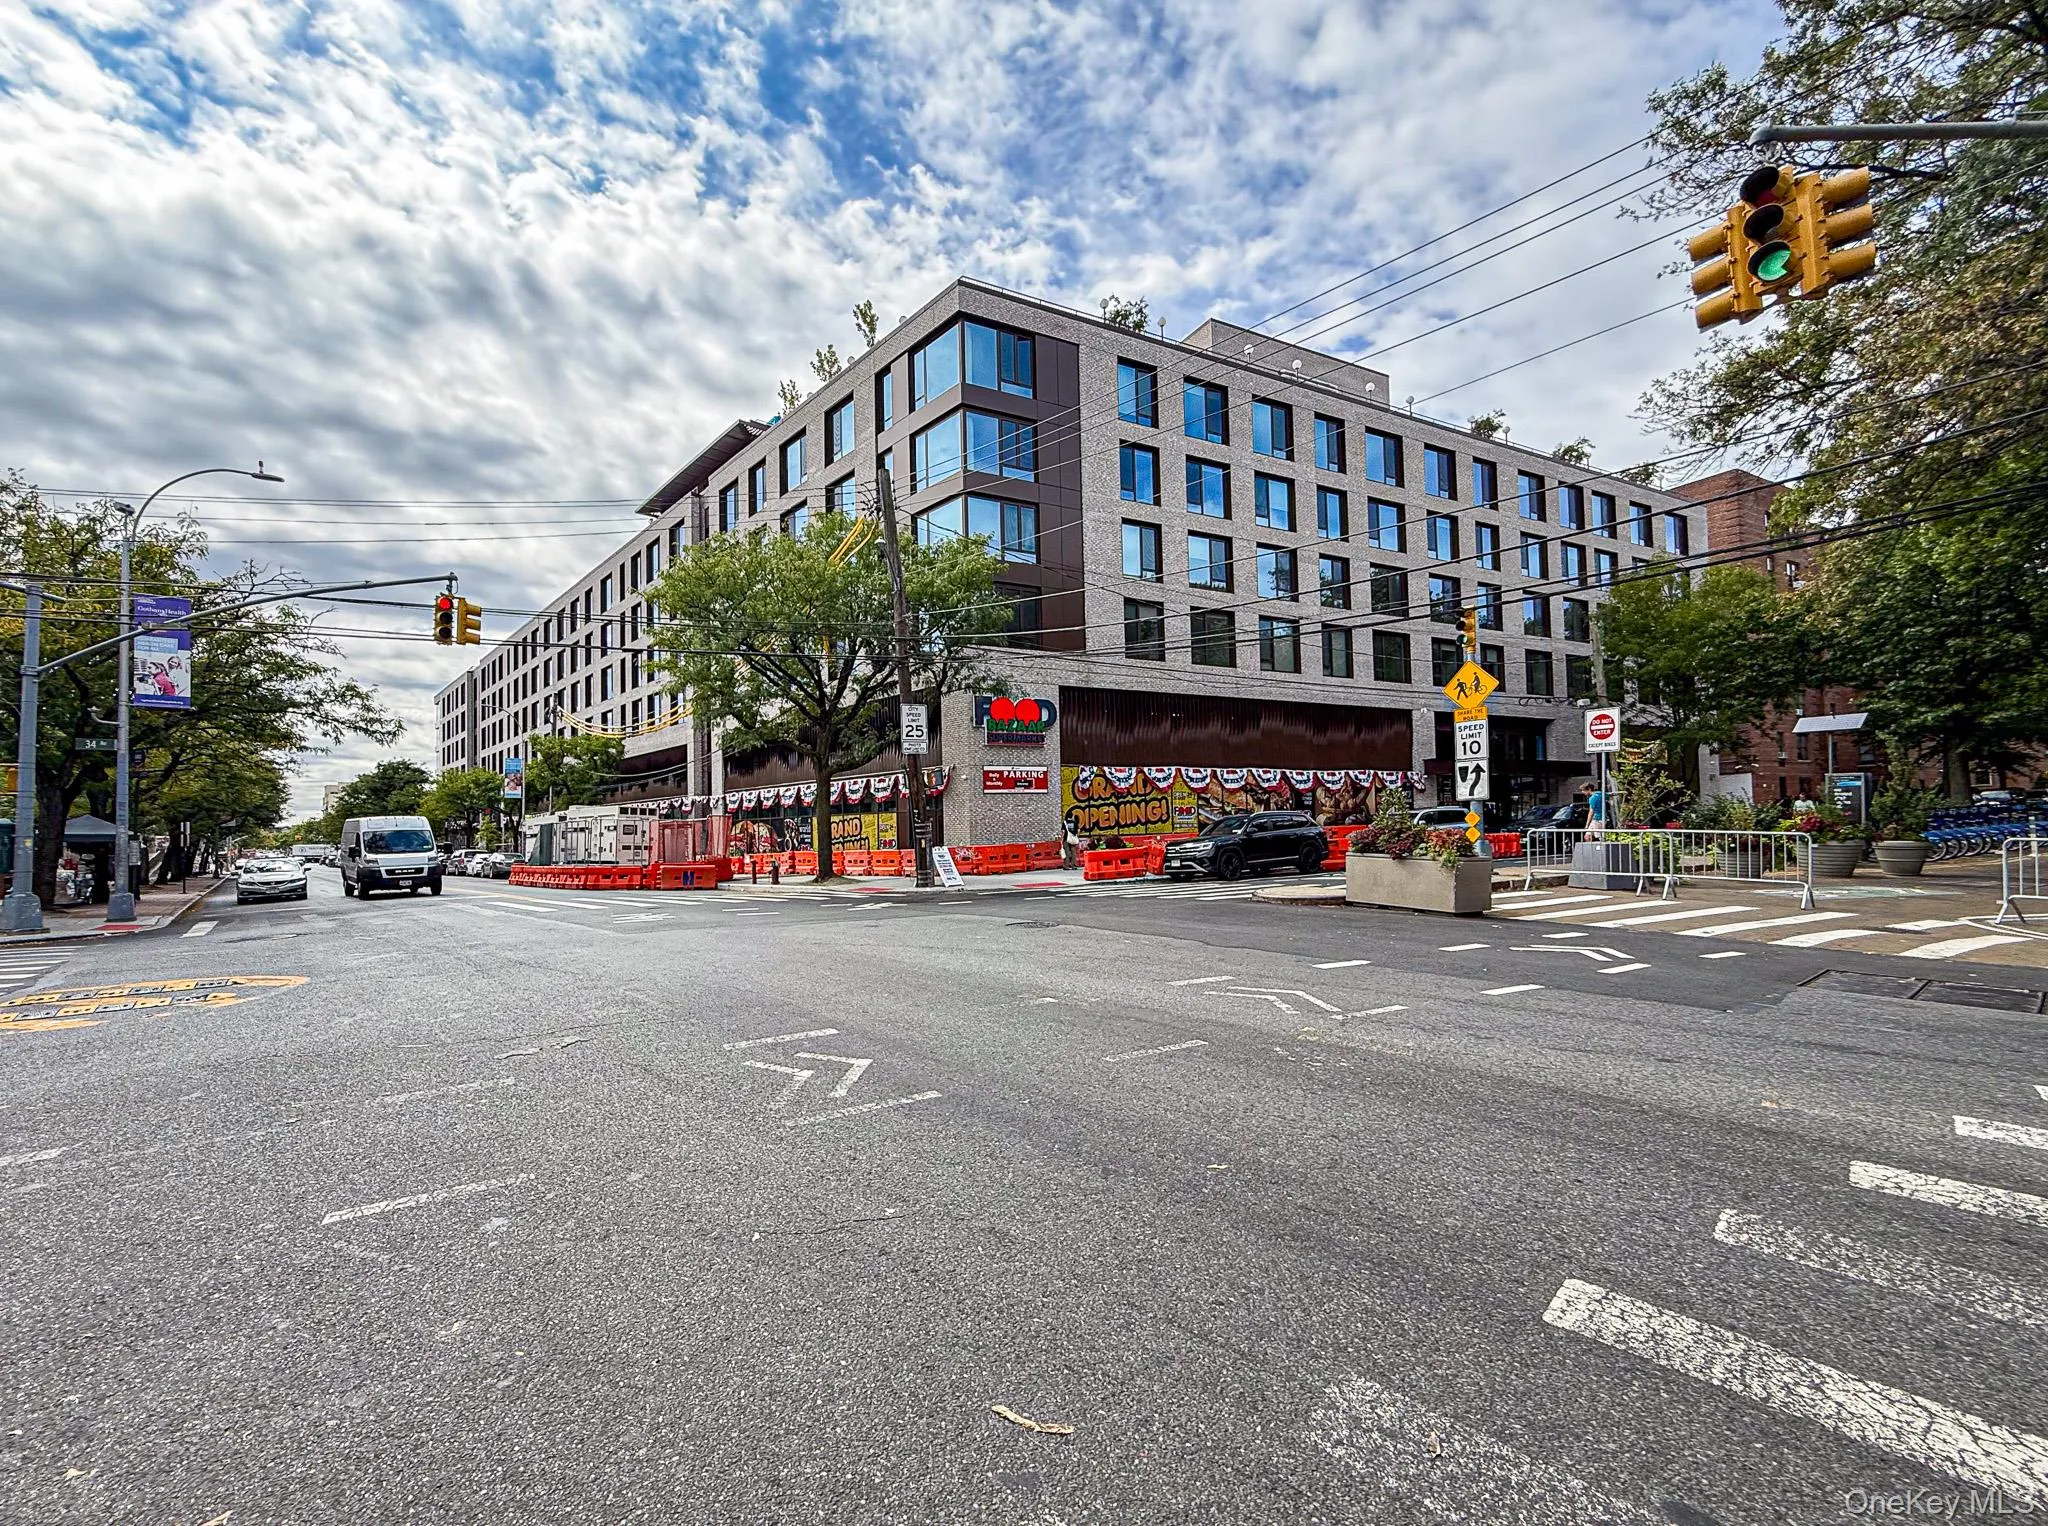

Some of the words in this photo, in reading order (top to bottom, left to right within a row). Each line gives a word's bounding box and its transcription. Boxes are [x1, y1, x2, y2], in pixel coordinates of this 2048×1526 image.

[905, 724, 924, 738] 25
[986, 718, 1045, 733] BAZAAR
[1458, 723, 1484, 732] SPEED
[1461, 732, 1482, 740] LIMIT
[85, 740, 97, 749] 34
[1462, 740, 1481, 755] 10
[1003, 770, 1044, 778] PARKING
[831, 818, 860, 838] RAND
